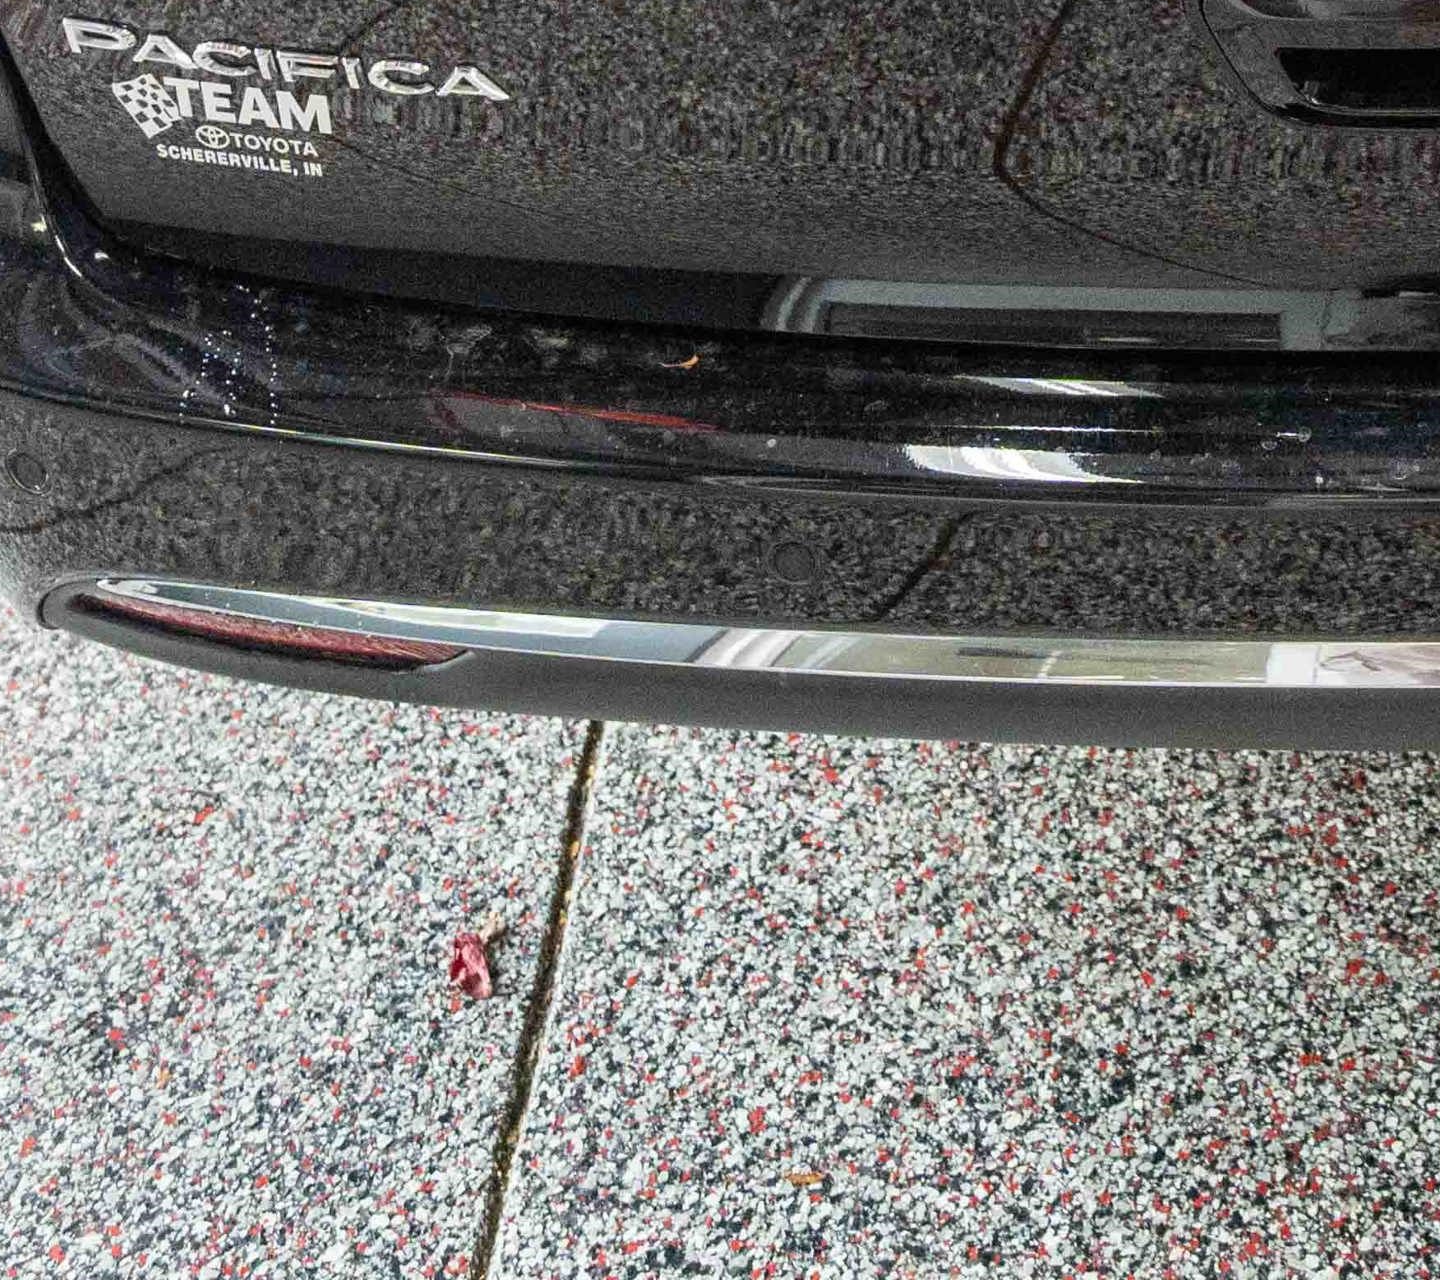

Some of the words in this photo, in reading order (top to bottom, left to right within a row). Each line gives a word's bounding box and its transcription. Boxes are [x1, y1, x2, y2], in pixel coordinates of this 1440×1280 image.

[62, 17, 510, 102] PACIFICA
[162, 76, 333, 135] TEAM
[156, 143, 299, 178] SCHERERVILLE,
[303, 160, 324, 178] IN
[229, 131, 320, 159] TOYOTA
